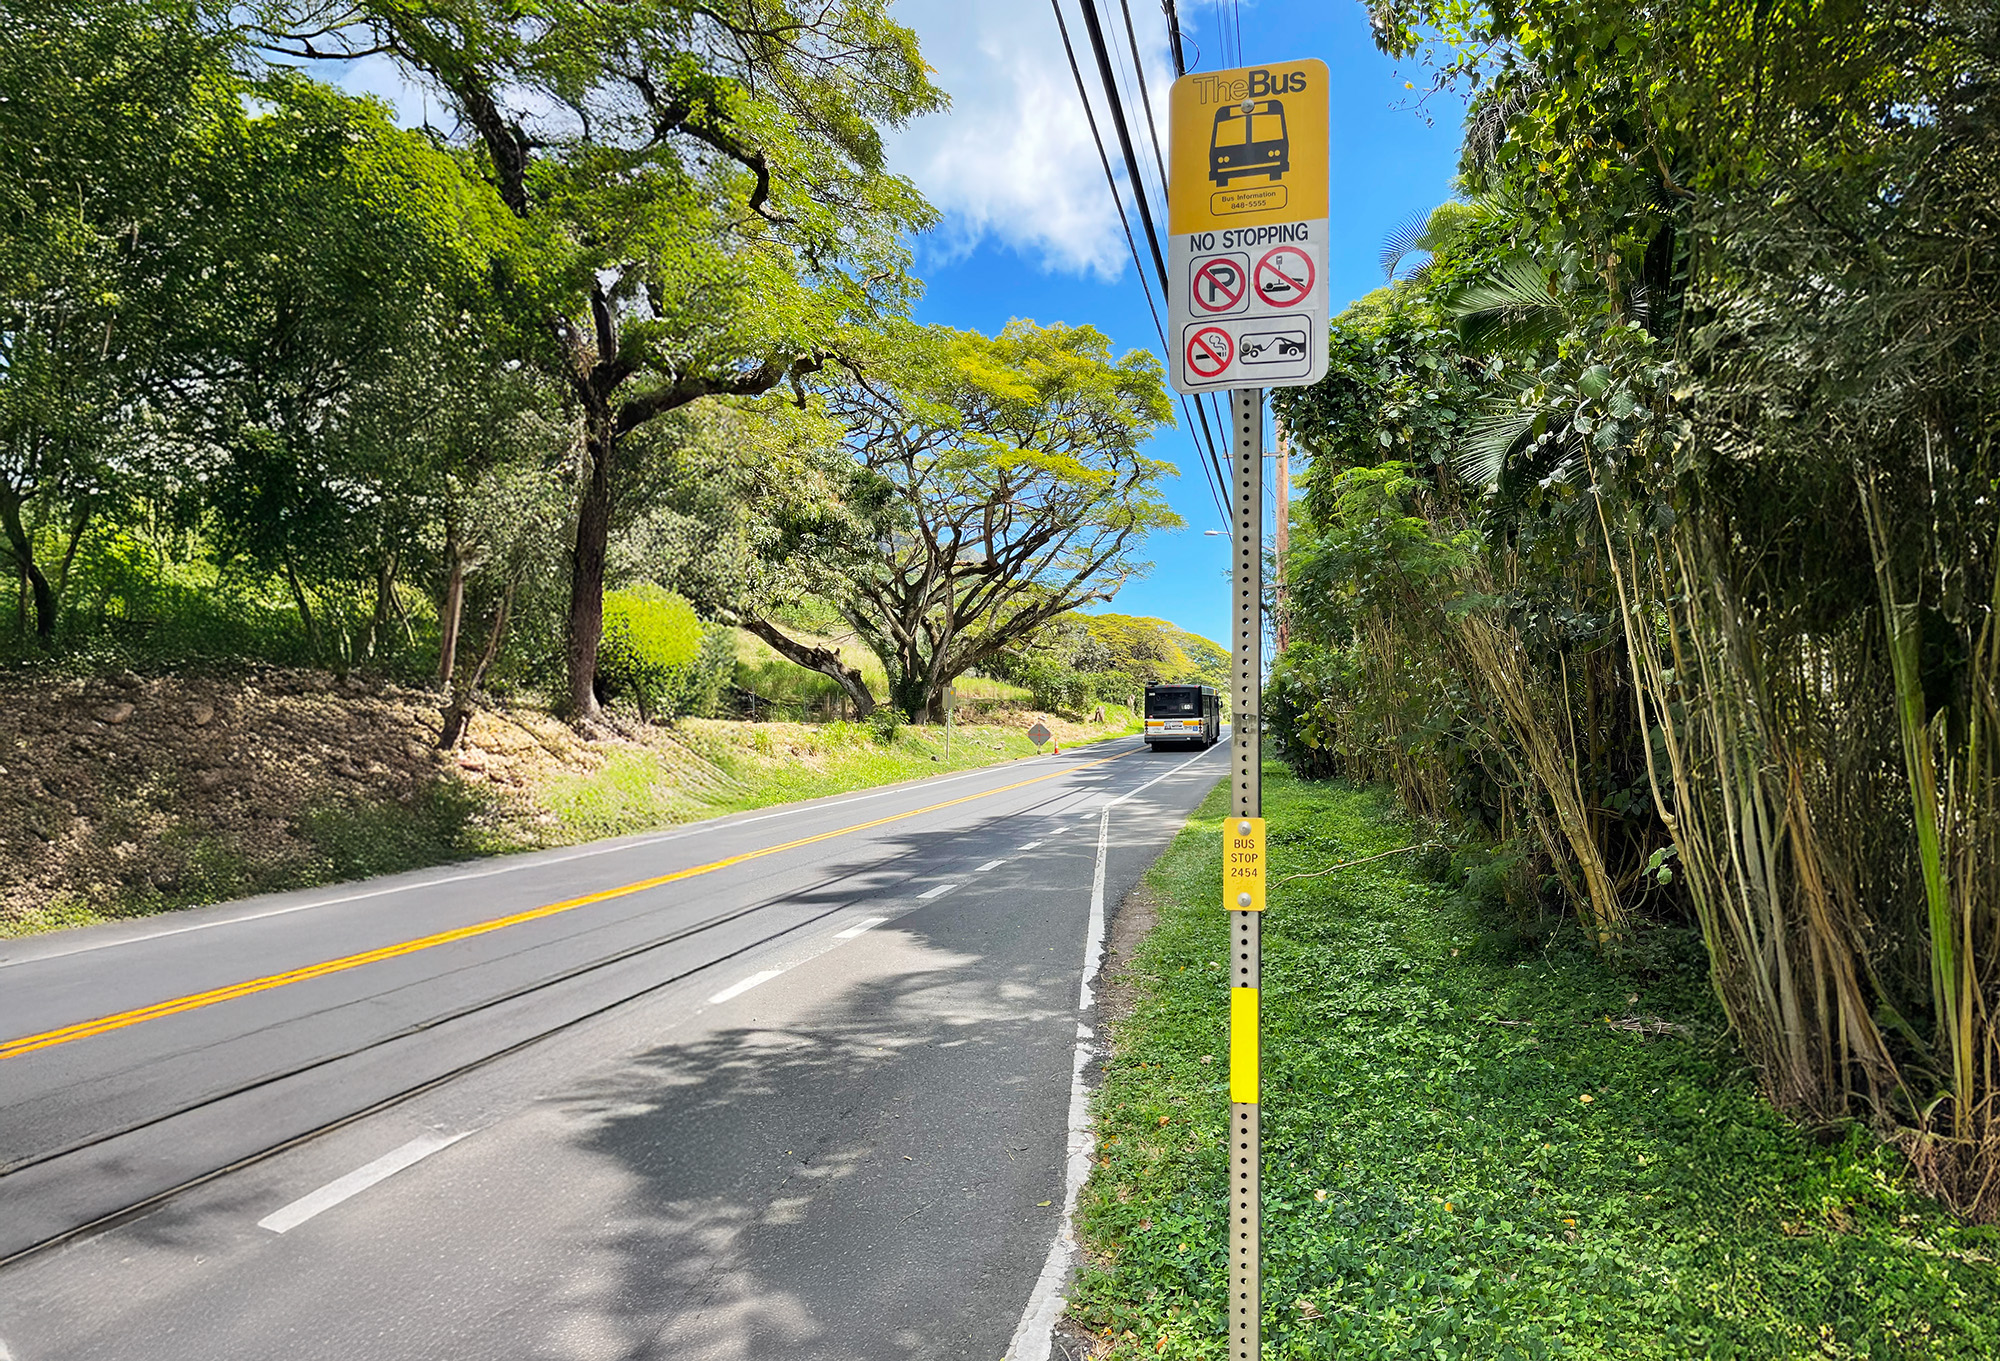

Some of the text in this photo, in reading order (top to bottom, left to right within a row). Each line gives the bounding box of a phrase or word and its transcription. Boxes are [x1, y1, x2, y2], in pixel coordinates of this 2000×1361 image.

[1193, 69, 1307, 105] TheBus
[1237, 191, 1276, 200] Information
[1231, 200, 1267, 209] 848-5555
[1190, 222, 1308, 252] NO STOPPING
[1234, 839, 1255, 849] BUS
[1230, 853, 1258, 863] STOP
[1231, 867, 1258, 877] 2454
